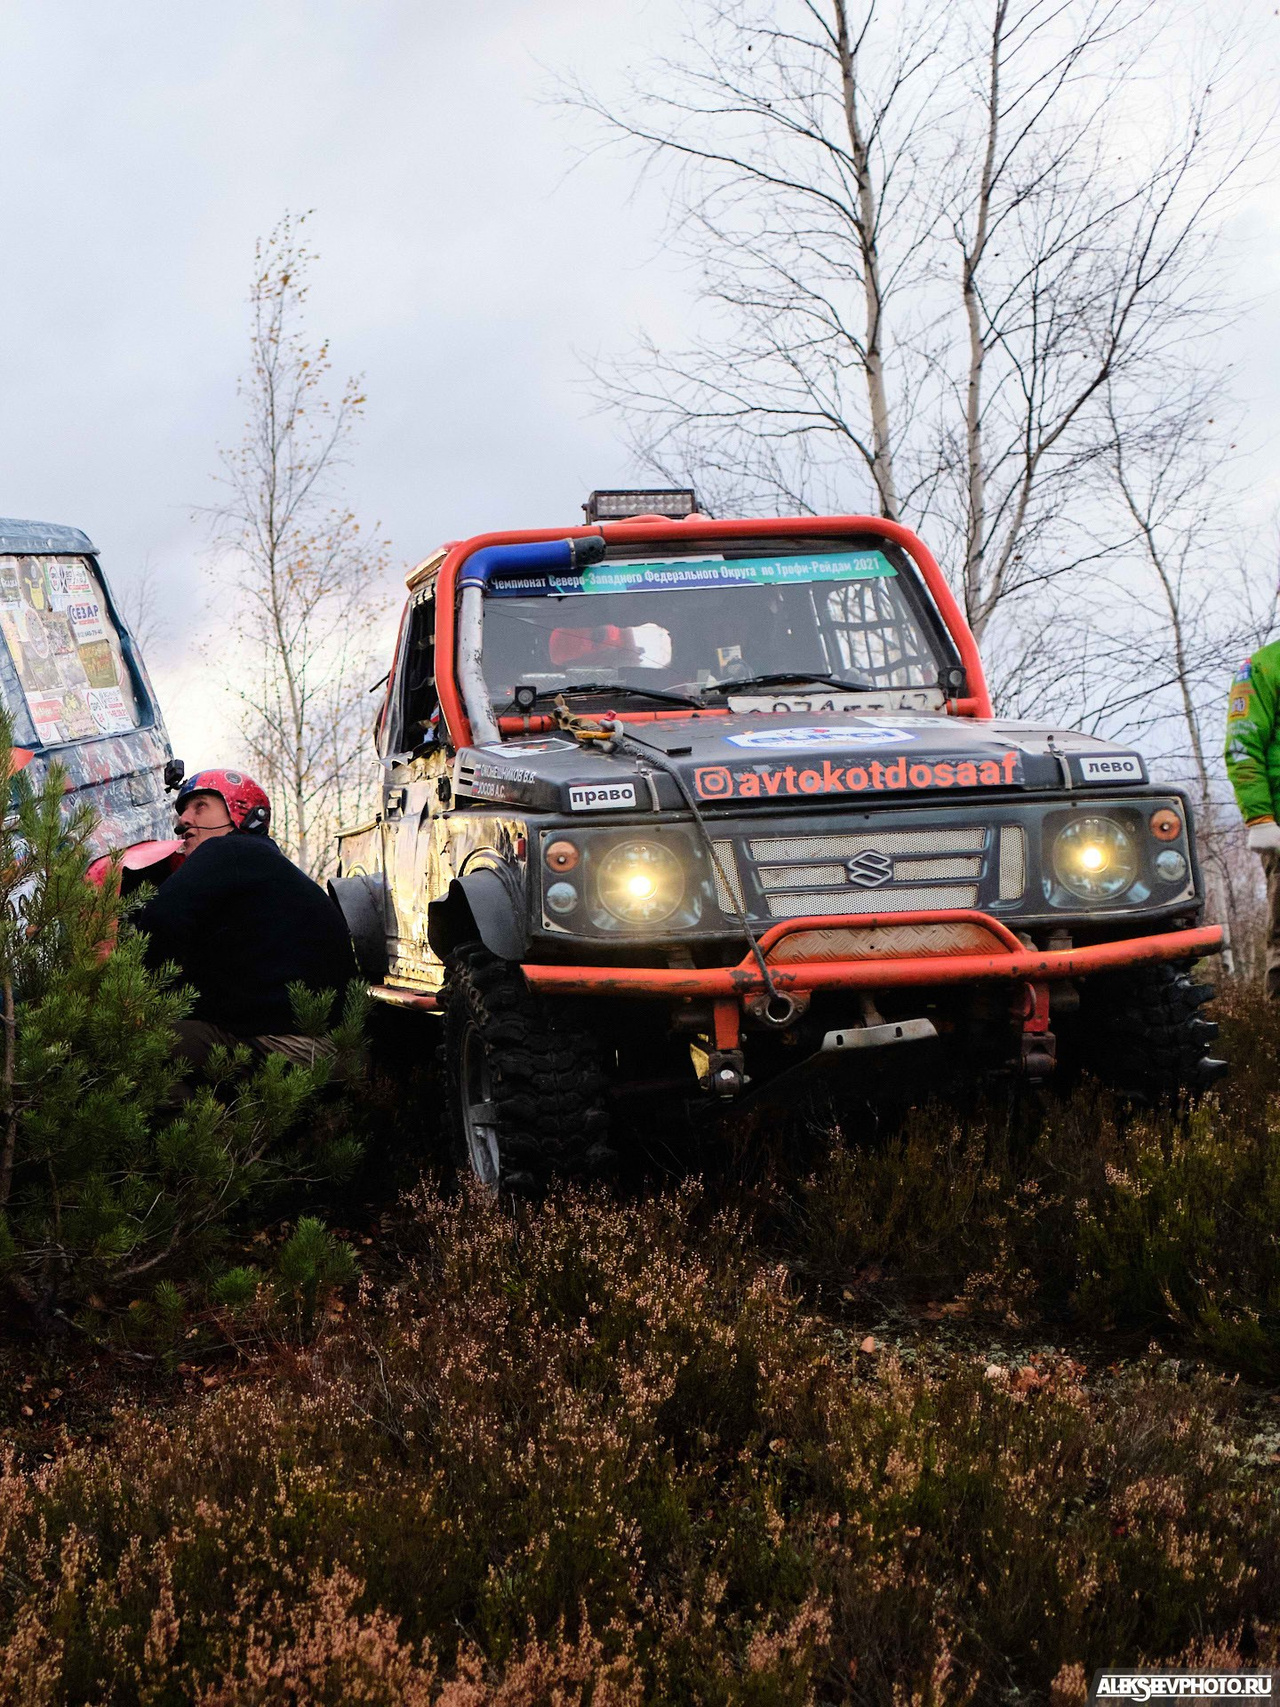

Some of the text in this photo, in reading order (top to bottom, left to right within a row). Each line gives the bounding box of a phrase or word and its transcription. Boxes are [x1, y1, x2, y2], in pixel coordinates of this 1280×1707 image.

[491, 557, 880, 591] Чемпионат Северо-Западного Федерального Округа по Трофи-Рейдам 2021
[738, 752, 1018, 797] avtokotdosaaf
[1089, 761, 1135, 773] лево
[572, 788, 633, 806] право
